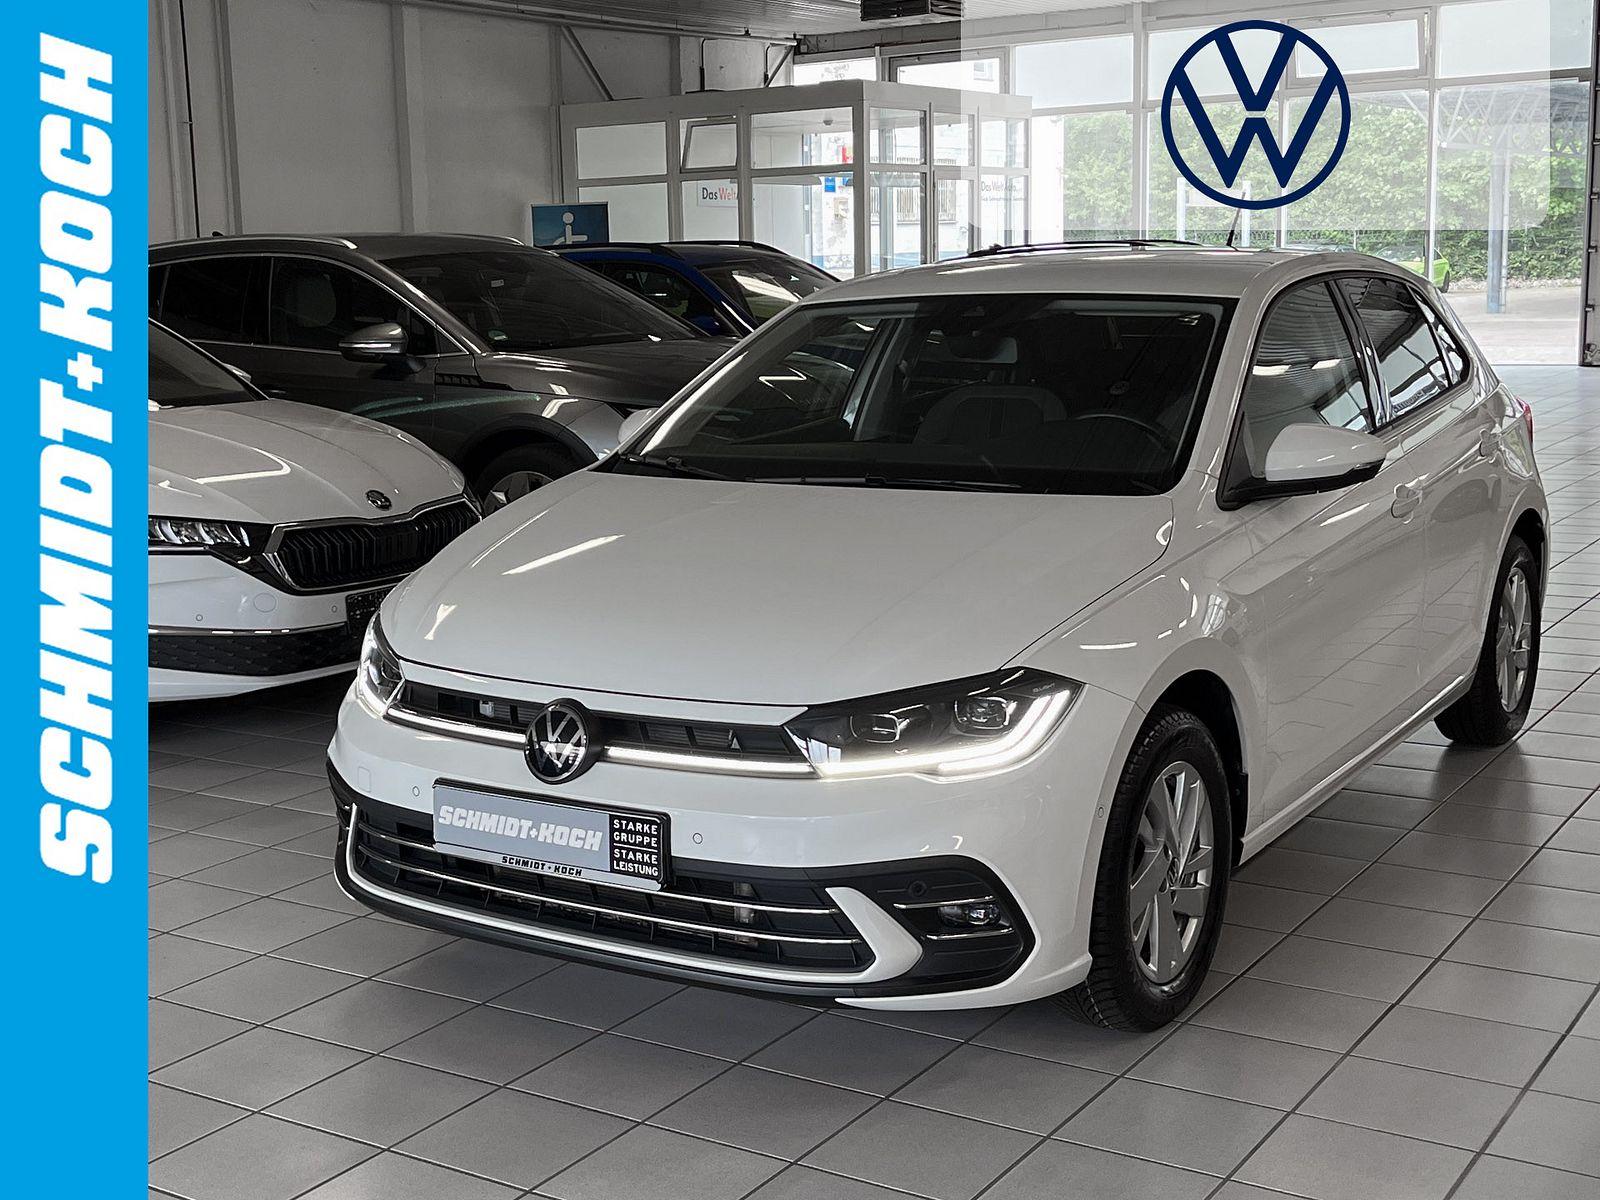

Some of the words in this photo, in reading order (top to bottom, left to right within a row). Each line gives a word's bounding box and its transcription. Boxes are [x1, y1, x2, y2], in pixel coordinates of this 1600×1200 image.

[702, 187, 718, 200] Das
[438, 805, 603, 851] SCHMIDT+KOCH
[613, 819, 658, 835] STARKE
[613, 831, 658, 847] GRUPPE
[613, 848, 658, 865] STARKE
[501, 856, 546, 870] SCHMIDT
[554, 865, 583, 877] KOCH
[613, 860, 658, 876] LEISTUNG
